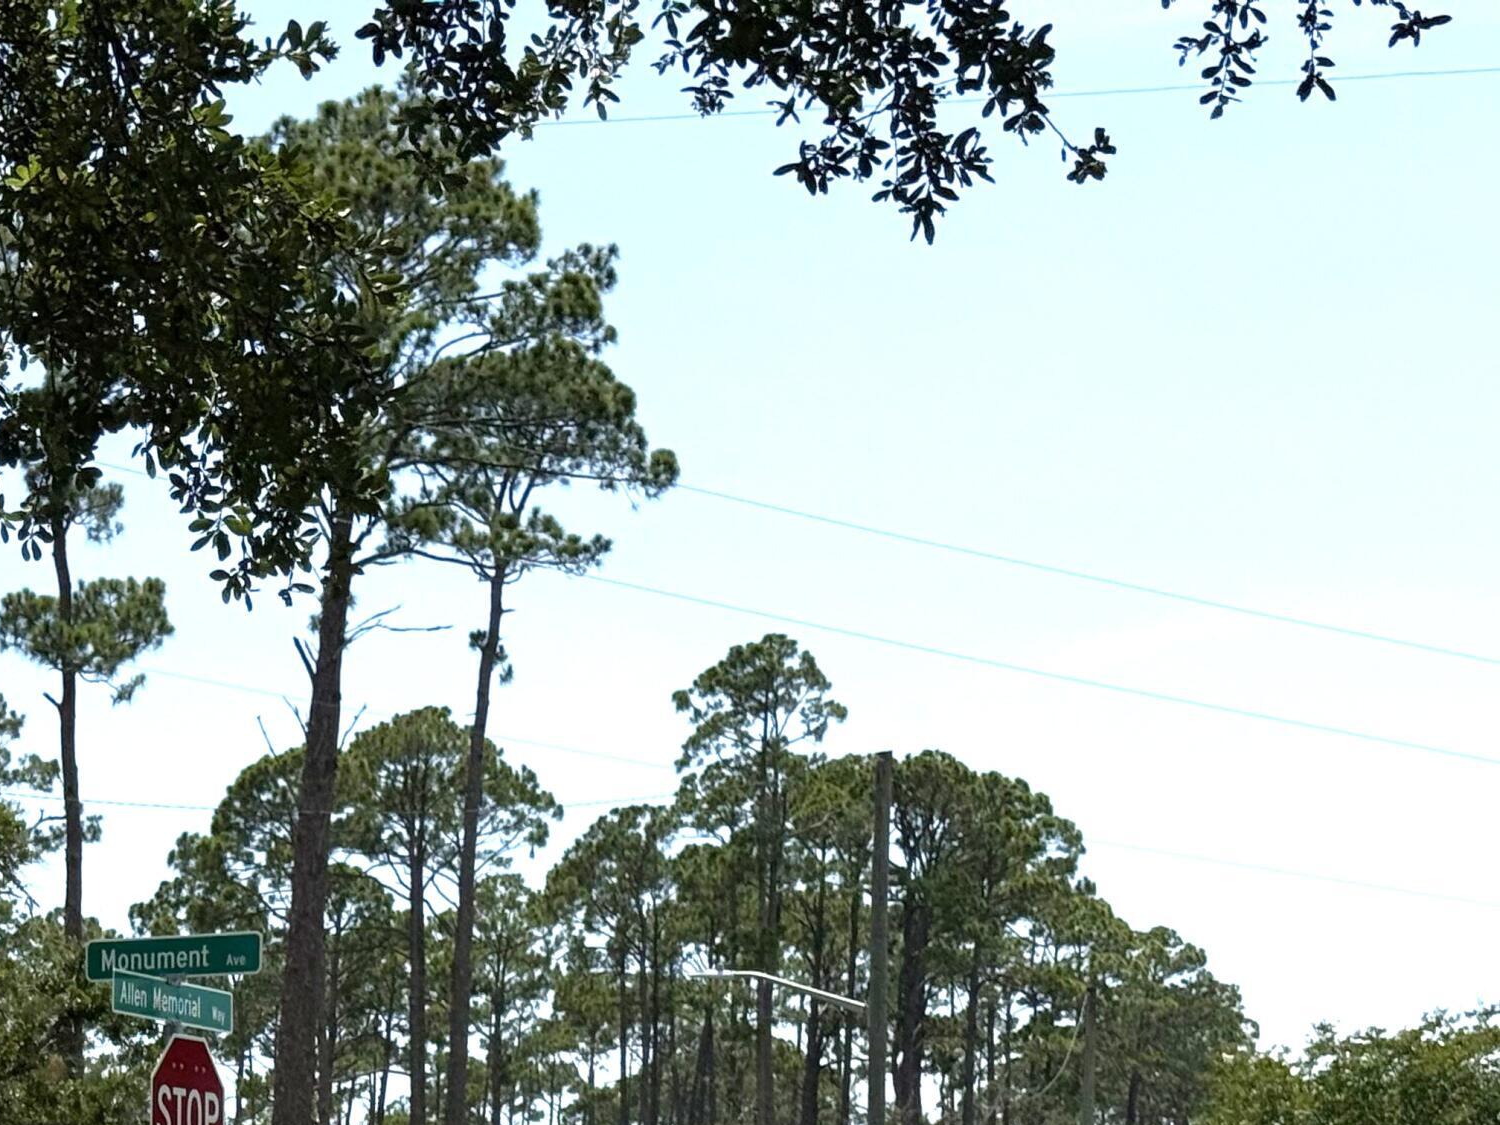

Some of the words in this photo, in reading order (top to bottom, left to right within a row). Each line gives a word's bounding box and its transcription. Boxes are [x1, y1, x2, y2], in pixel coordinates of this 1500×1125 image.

[101, 944, 210, 973] Monument
[226, 953, 246, 966] Ave
[120, 981, 148, 1008] Allen
[153, 986, 201, 1018] Memorial
[212, 1005, 226, 1026] Way
